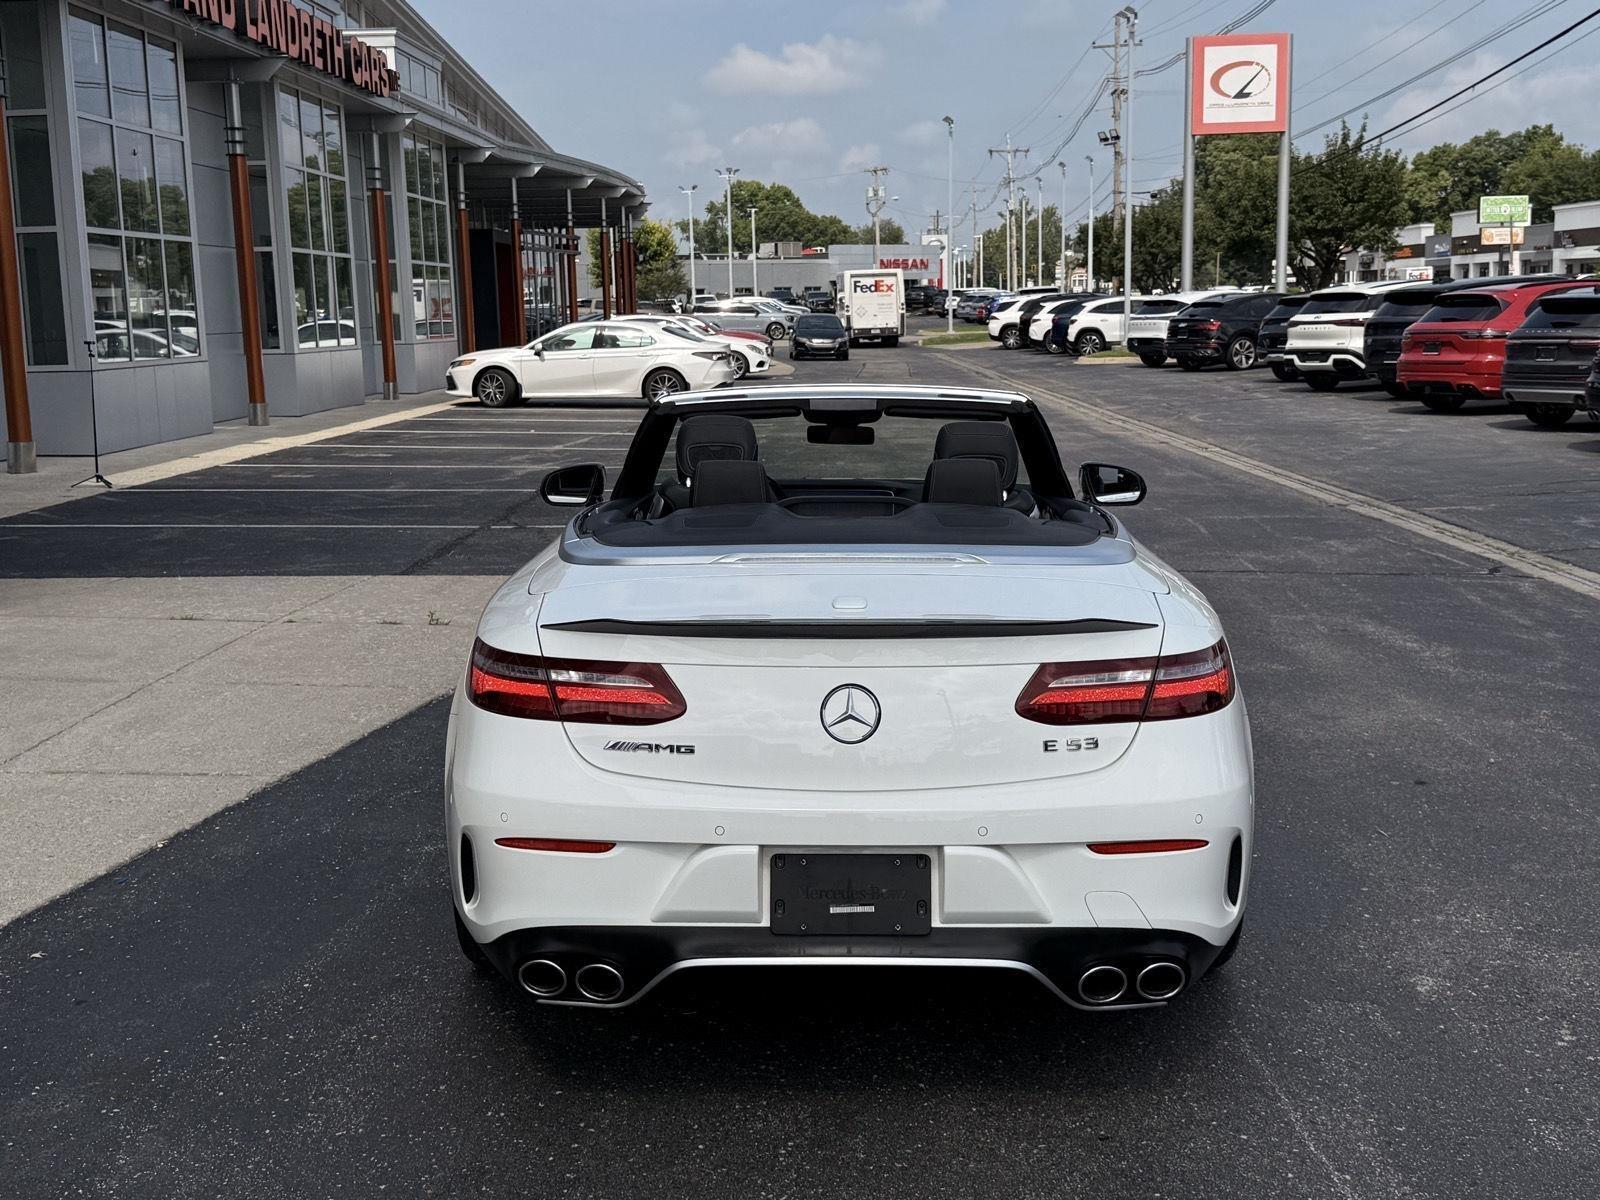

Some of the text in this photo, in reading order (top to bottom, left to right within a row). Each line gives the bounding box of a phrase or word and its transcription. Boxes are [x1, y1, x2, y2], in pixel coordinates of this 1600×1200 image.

[244, 0, 346, 79] LANDRETH
[350, 35, 390, 97] CARS
[879, 259, 929, 270] NISSAN
[853, 280, 894, 293] FedEx
[1043, 737, 1099, 752] E 53
